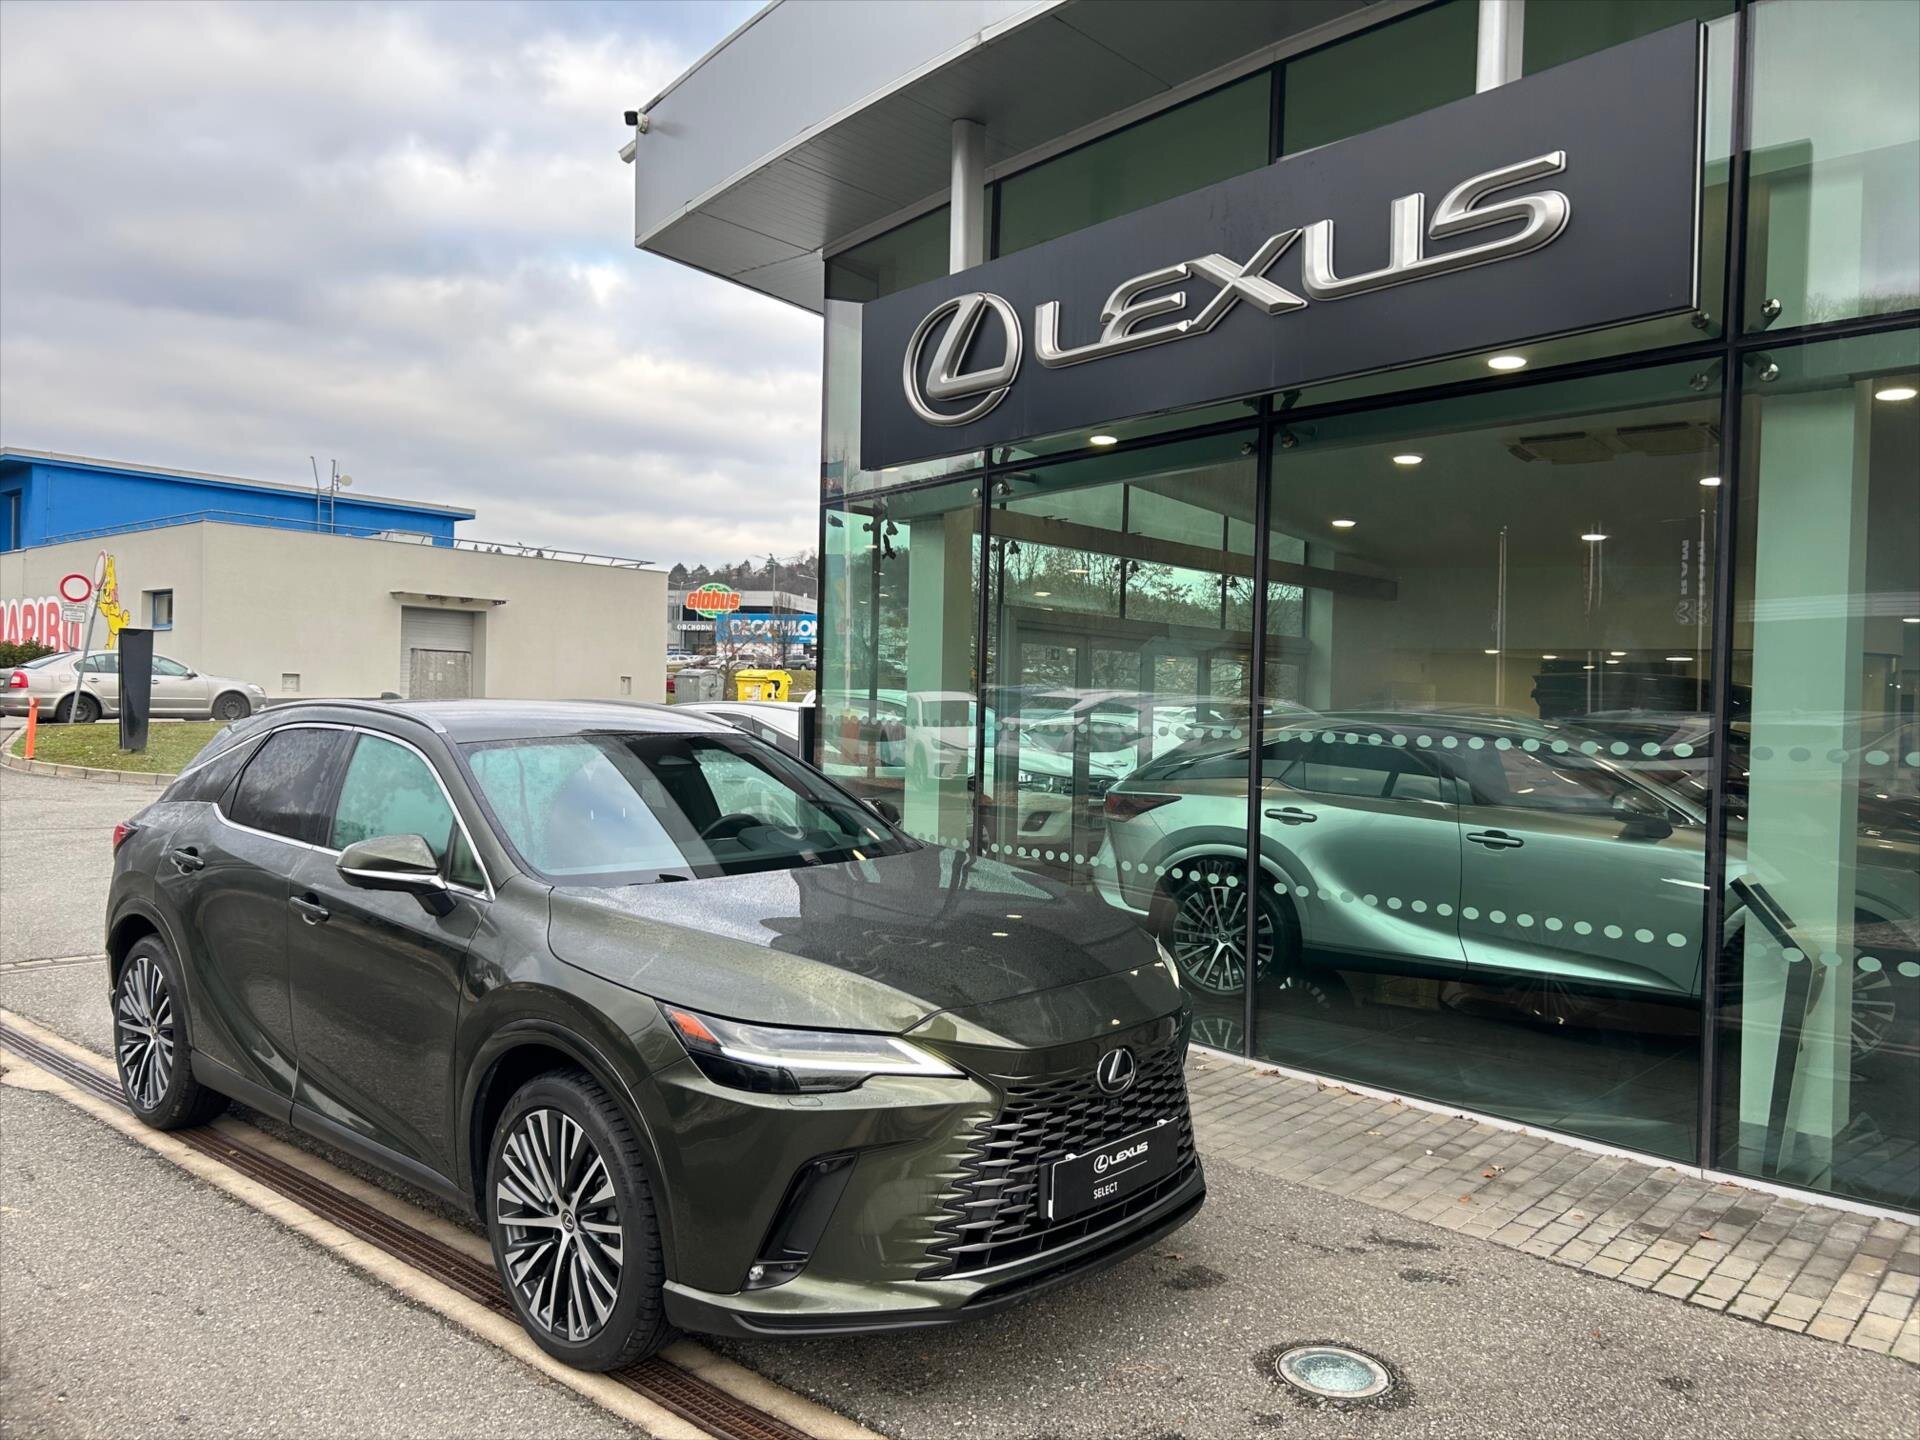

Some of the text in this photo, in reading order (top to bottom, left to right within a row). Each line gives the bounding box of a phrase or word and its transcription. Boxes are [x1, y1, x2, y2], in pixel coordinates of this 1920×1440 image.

[1034, 150, 1571, 369] LEXUS
[1109, 1141, 1149, 1165] LEXUS
[1093, 1181, 1118, 1199] SELECT
